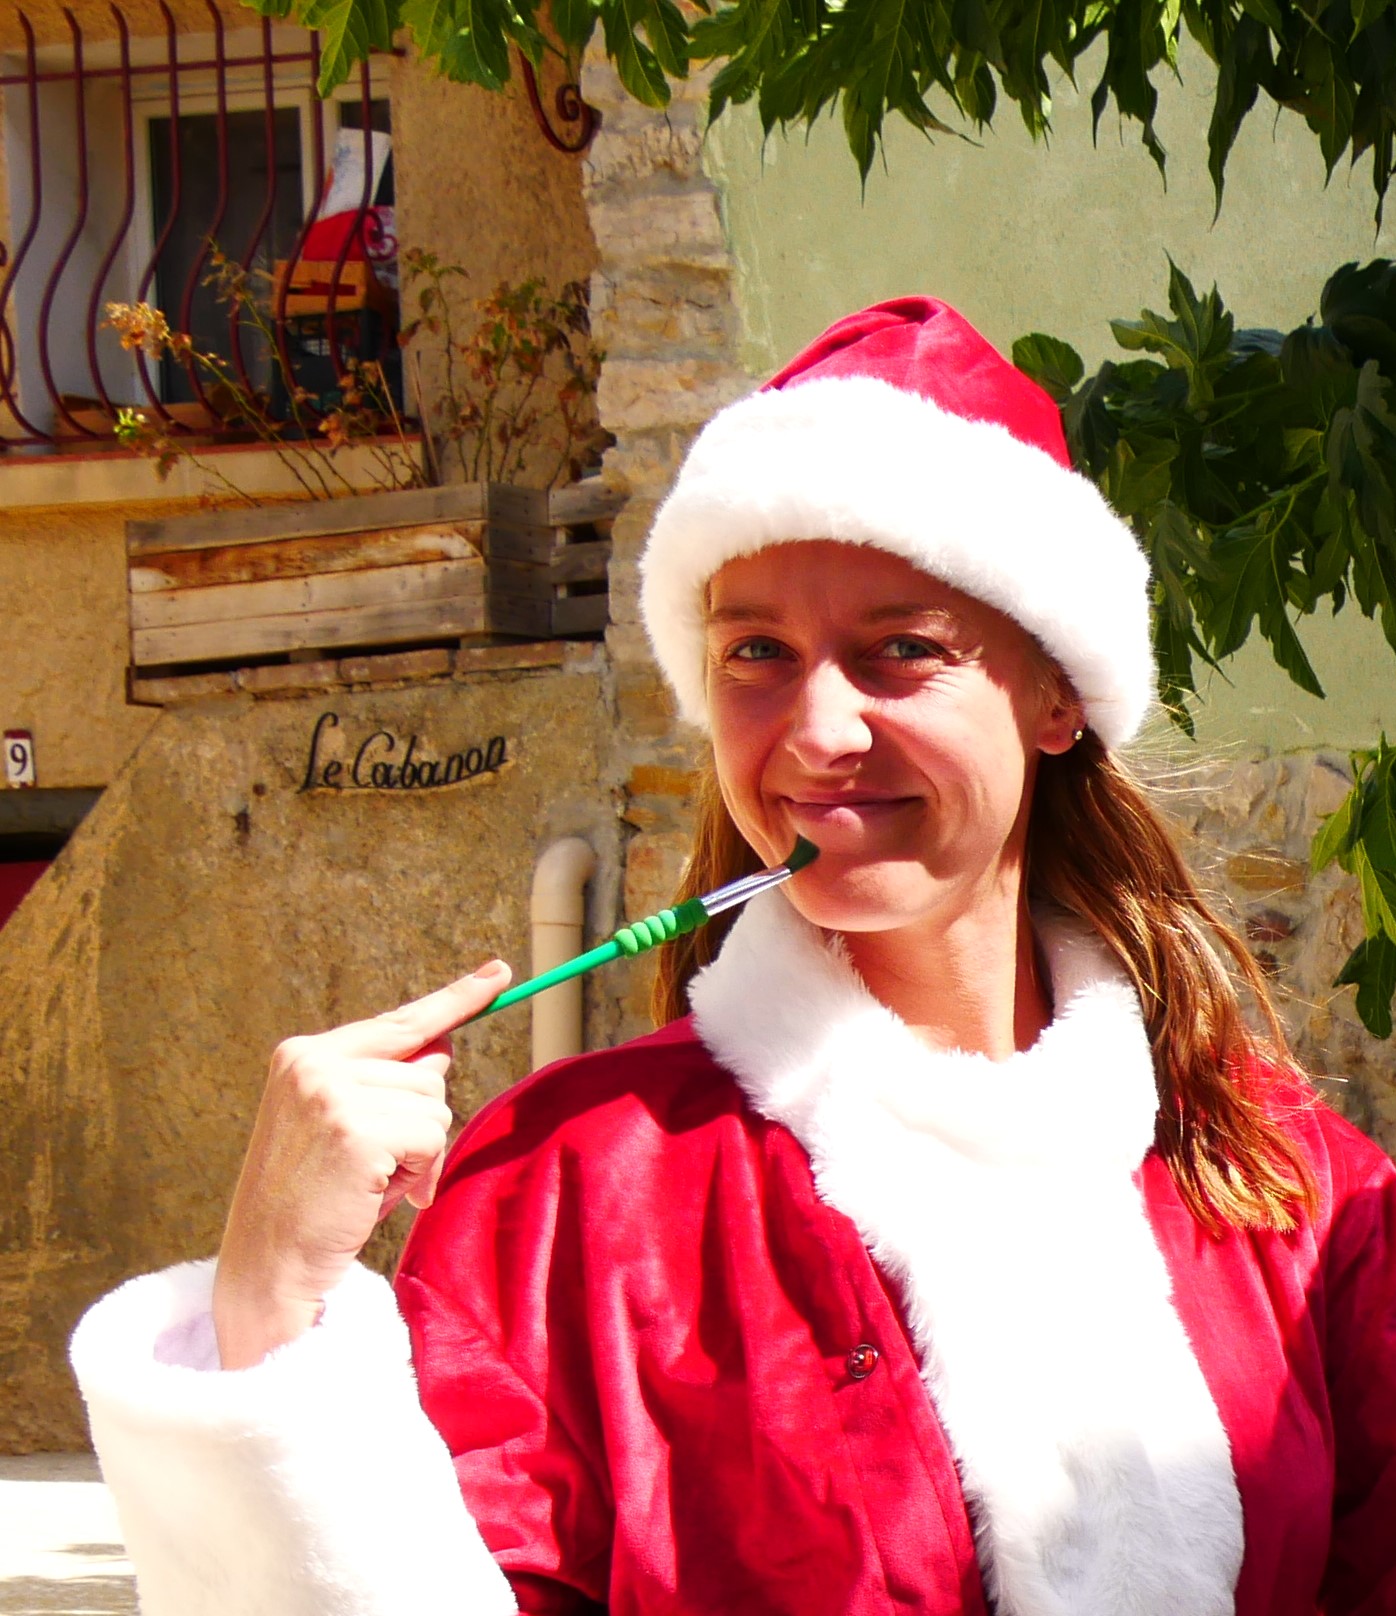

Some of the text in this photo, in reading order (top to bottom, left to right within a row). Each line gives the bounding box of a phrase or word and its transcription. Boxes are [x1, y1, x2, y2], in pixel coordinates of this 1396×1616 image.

[10, 743, 28, 777] 9
[296, 711, 509, 794] Le Cabanon
